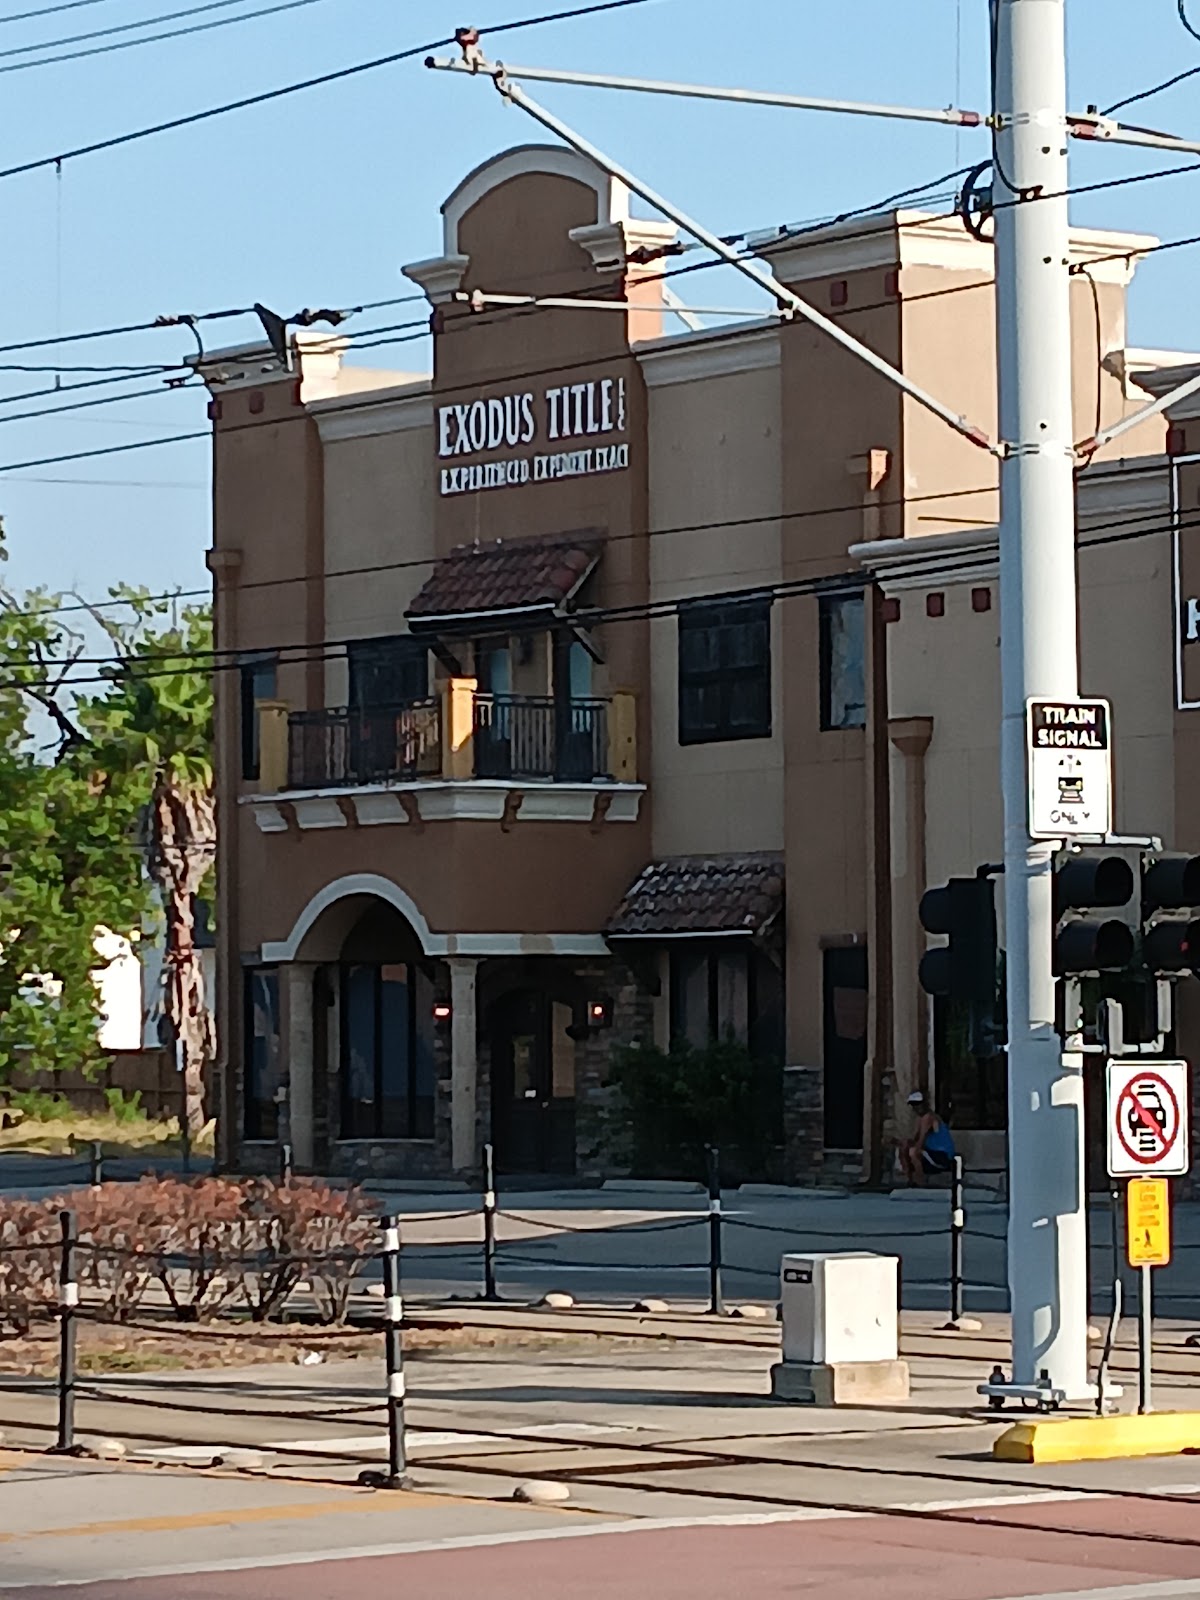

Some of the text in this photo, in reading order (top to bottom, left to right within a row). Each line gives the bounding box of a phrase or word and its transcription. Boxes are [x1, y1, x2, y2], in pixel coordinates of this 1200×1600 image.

[438, 379, 613, 456] EXODUS TITLE
[1043, 706, 1096, 724] TRAIN
[1037, 728, 1102, 747] SIGNAL
[1050, 810, 1090, 825] ONLY
